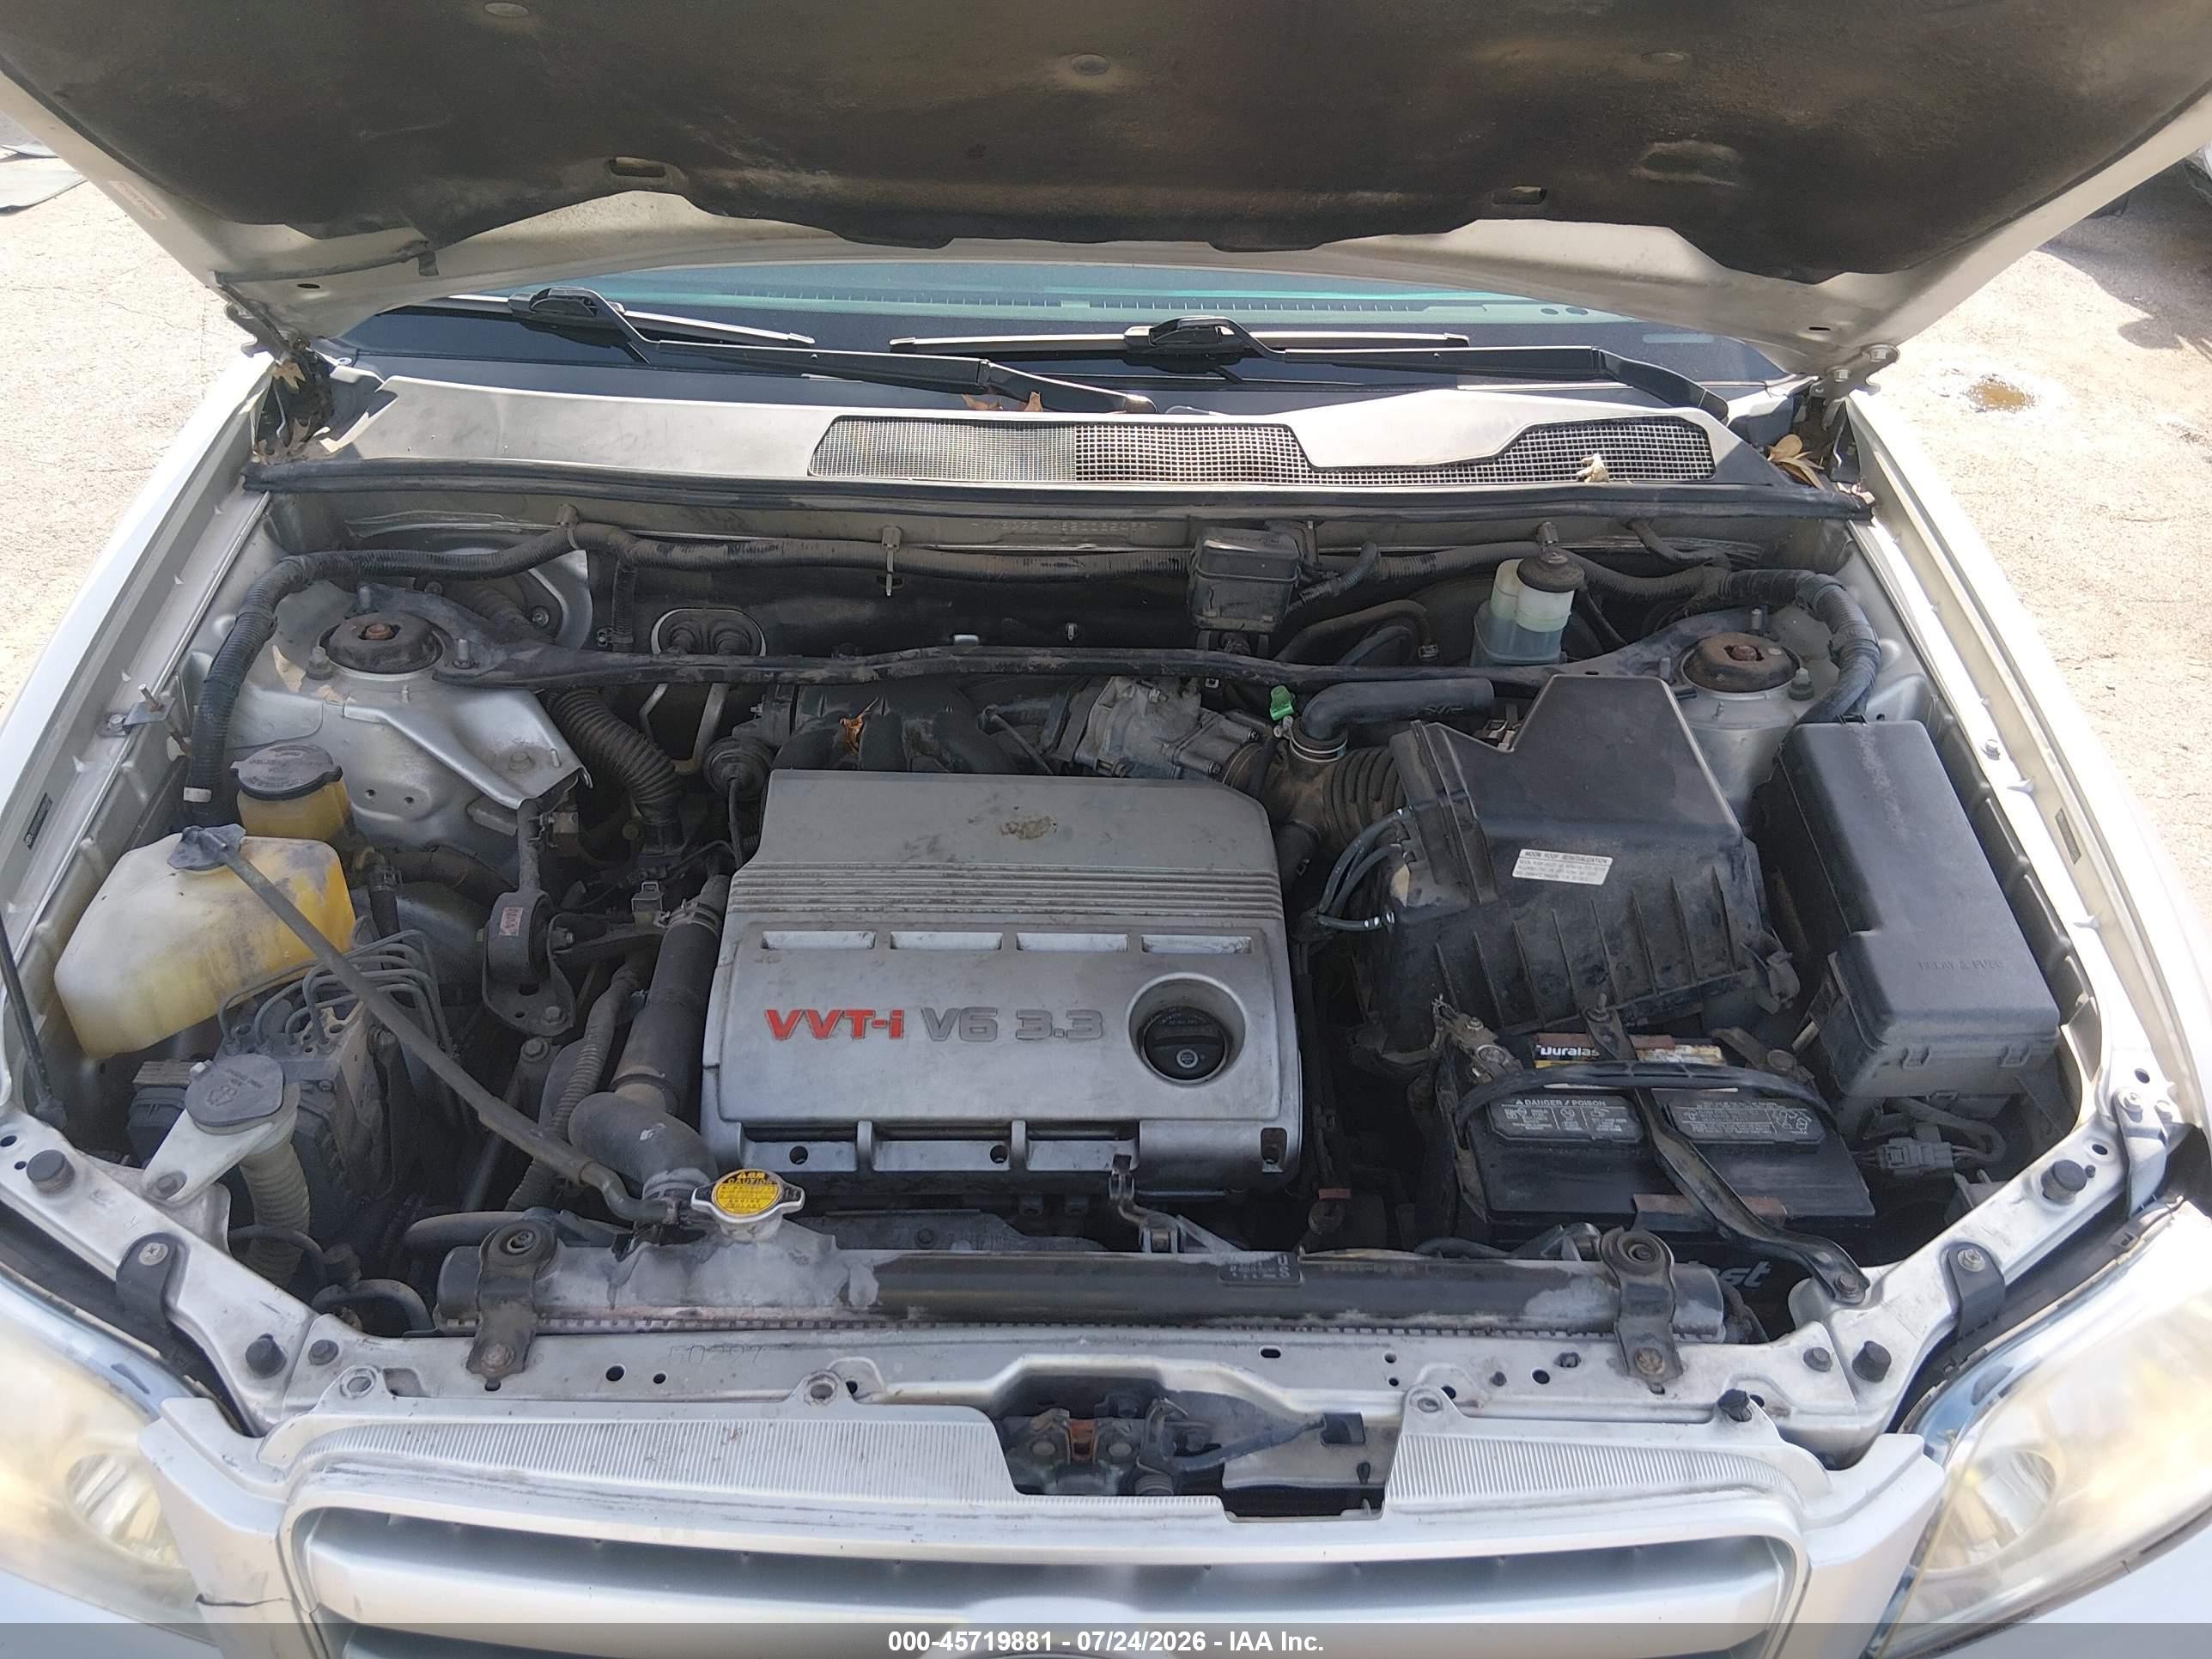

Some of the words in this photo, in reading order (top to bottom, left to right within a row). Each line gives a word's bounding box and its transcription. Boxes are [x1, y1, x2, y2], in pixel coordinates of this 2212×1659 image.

[763, 1008, 905, 1041] VVT-i
[921, 1006, 999, 1042] V6
[1016, 1008, 1104, 1042] 3.3
[1536, 1044, 1601, 1057] Duralas
